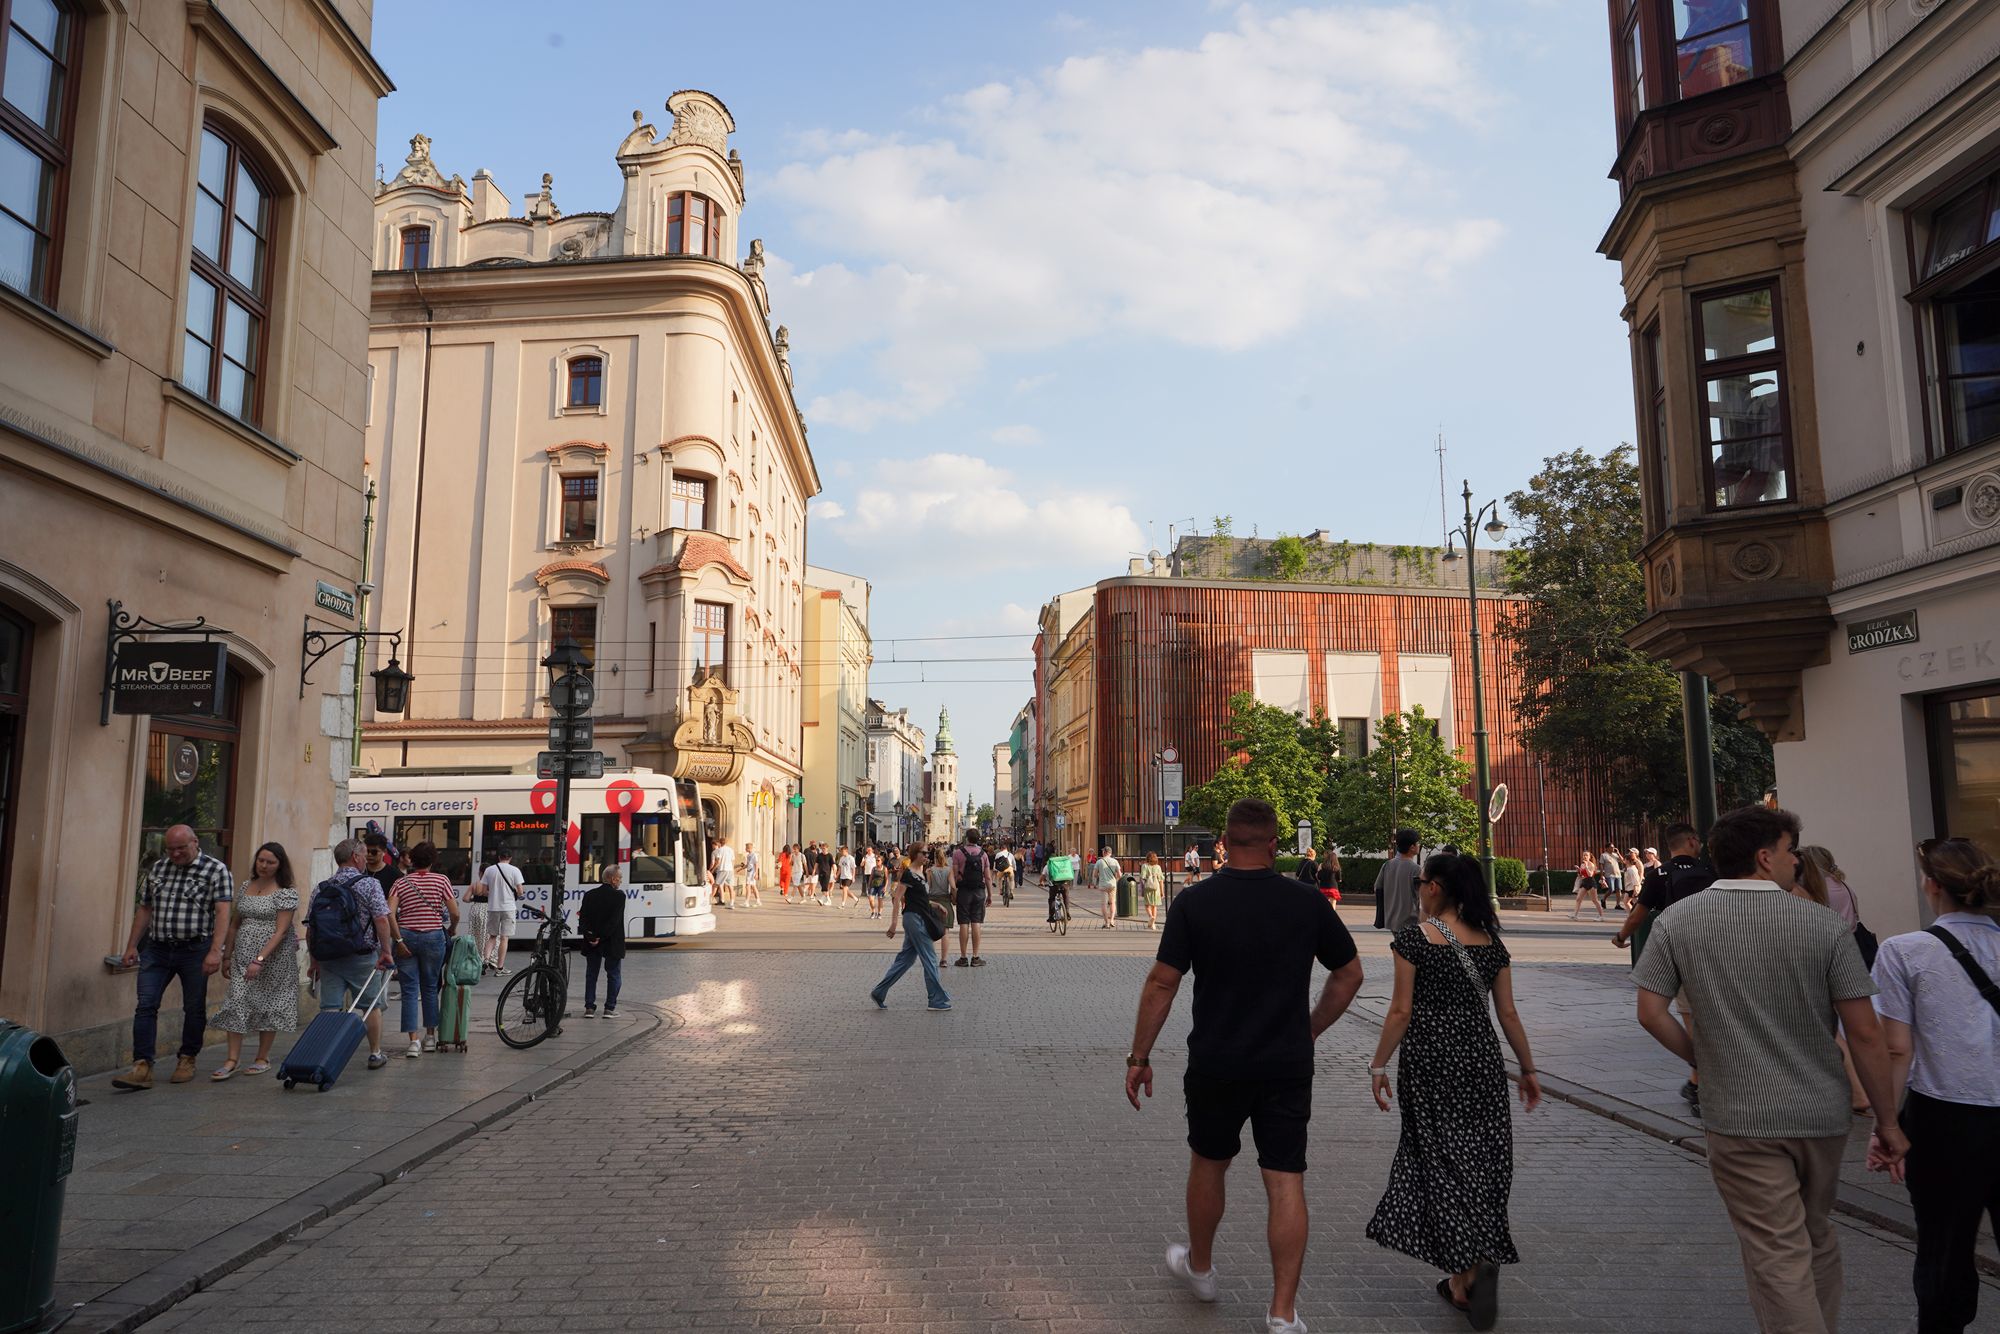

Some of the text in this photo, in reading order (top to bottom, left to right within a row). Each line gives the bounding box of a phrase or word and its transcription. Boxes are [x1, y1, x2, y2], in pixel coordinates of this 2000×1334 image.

[1866, 621, 1890, 631] ULICA
[1848, 625, 1915, 650] GRODZKA
[347, 802, 380, 812] esco
[384, 799, 416, 811] Tech
